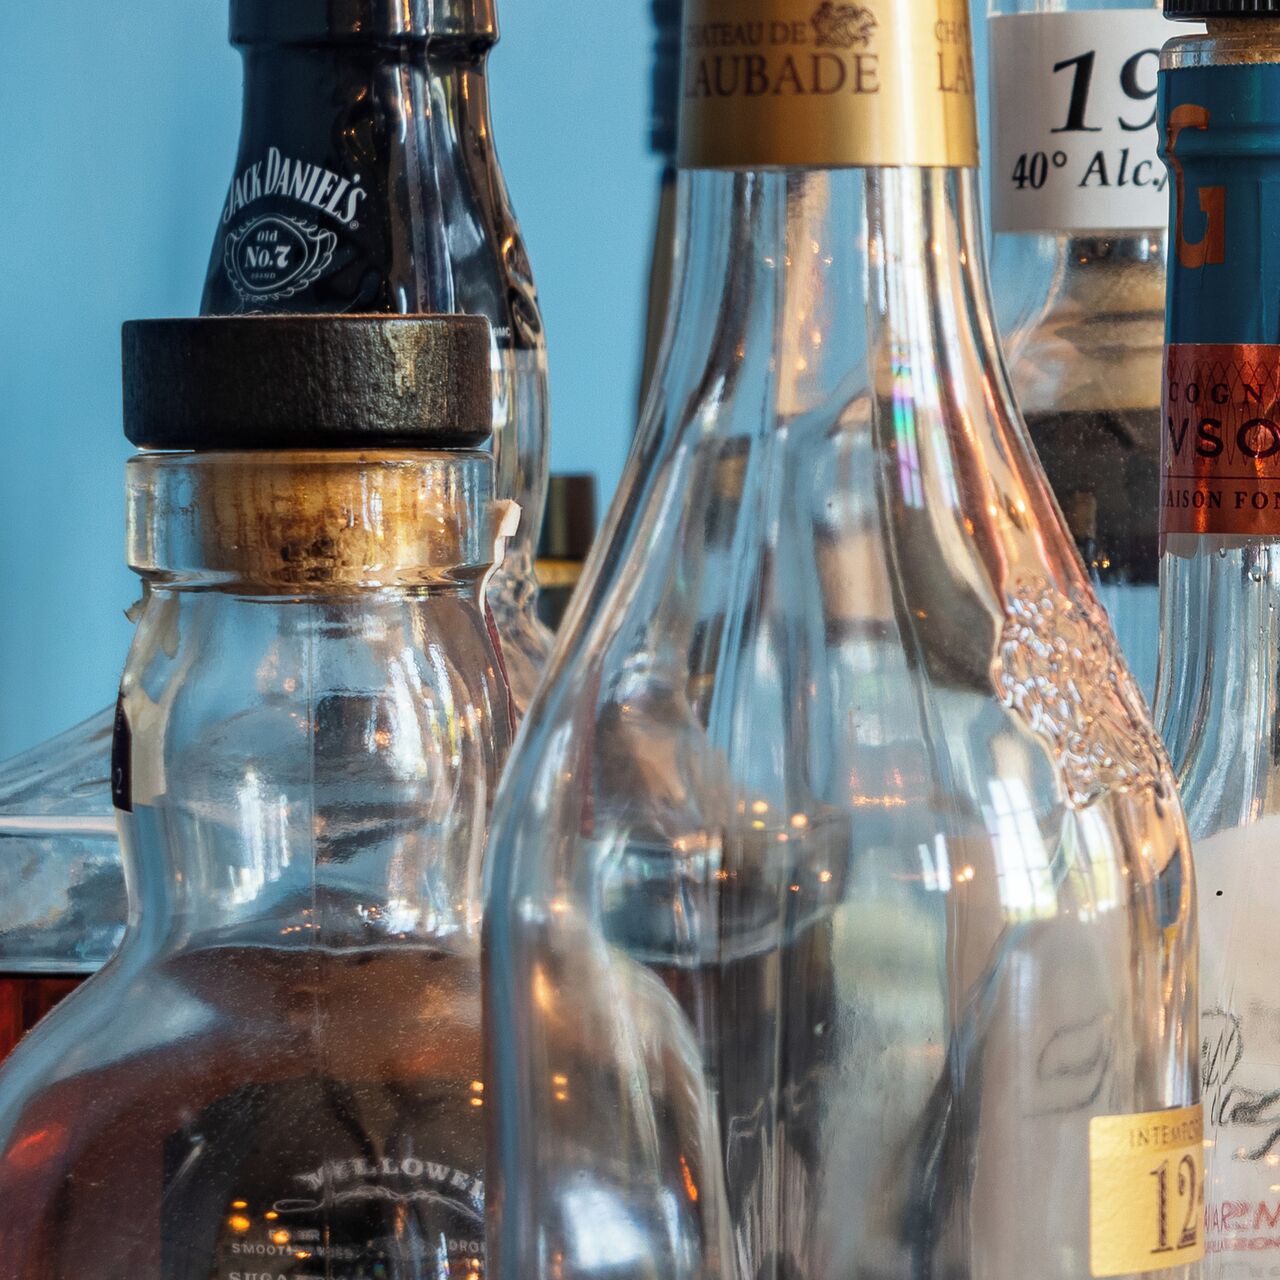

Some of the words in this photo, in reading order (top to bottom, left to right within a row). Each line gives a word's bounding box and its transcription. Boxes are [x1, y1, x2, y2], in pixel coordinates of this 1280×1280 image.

[770, 20, 806, 46] DE
[686, 52, 880, 99] AUBADE
[222, 158, 263, 224] JACK
[264, 146, 367, 225] DANIEL'S
[1012, 149, 1068, 191] 40°
[256, 229, 278, 243] Old
[1163, 490, 1223, 510] AISON
[1149, 1153, 1198, 1254] 12
